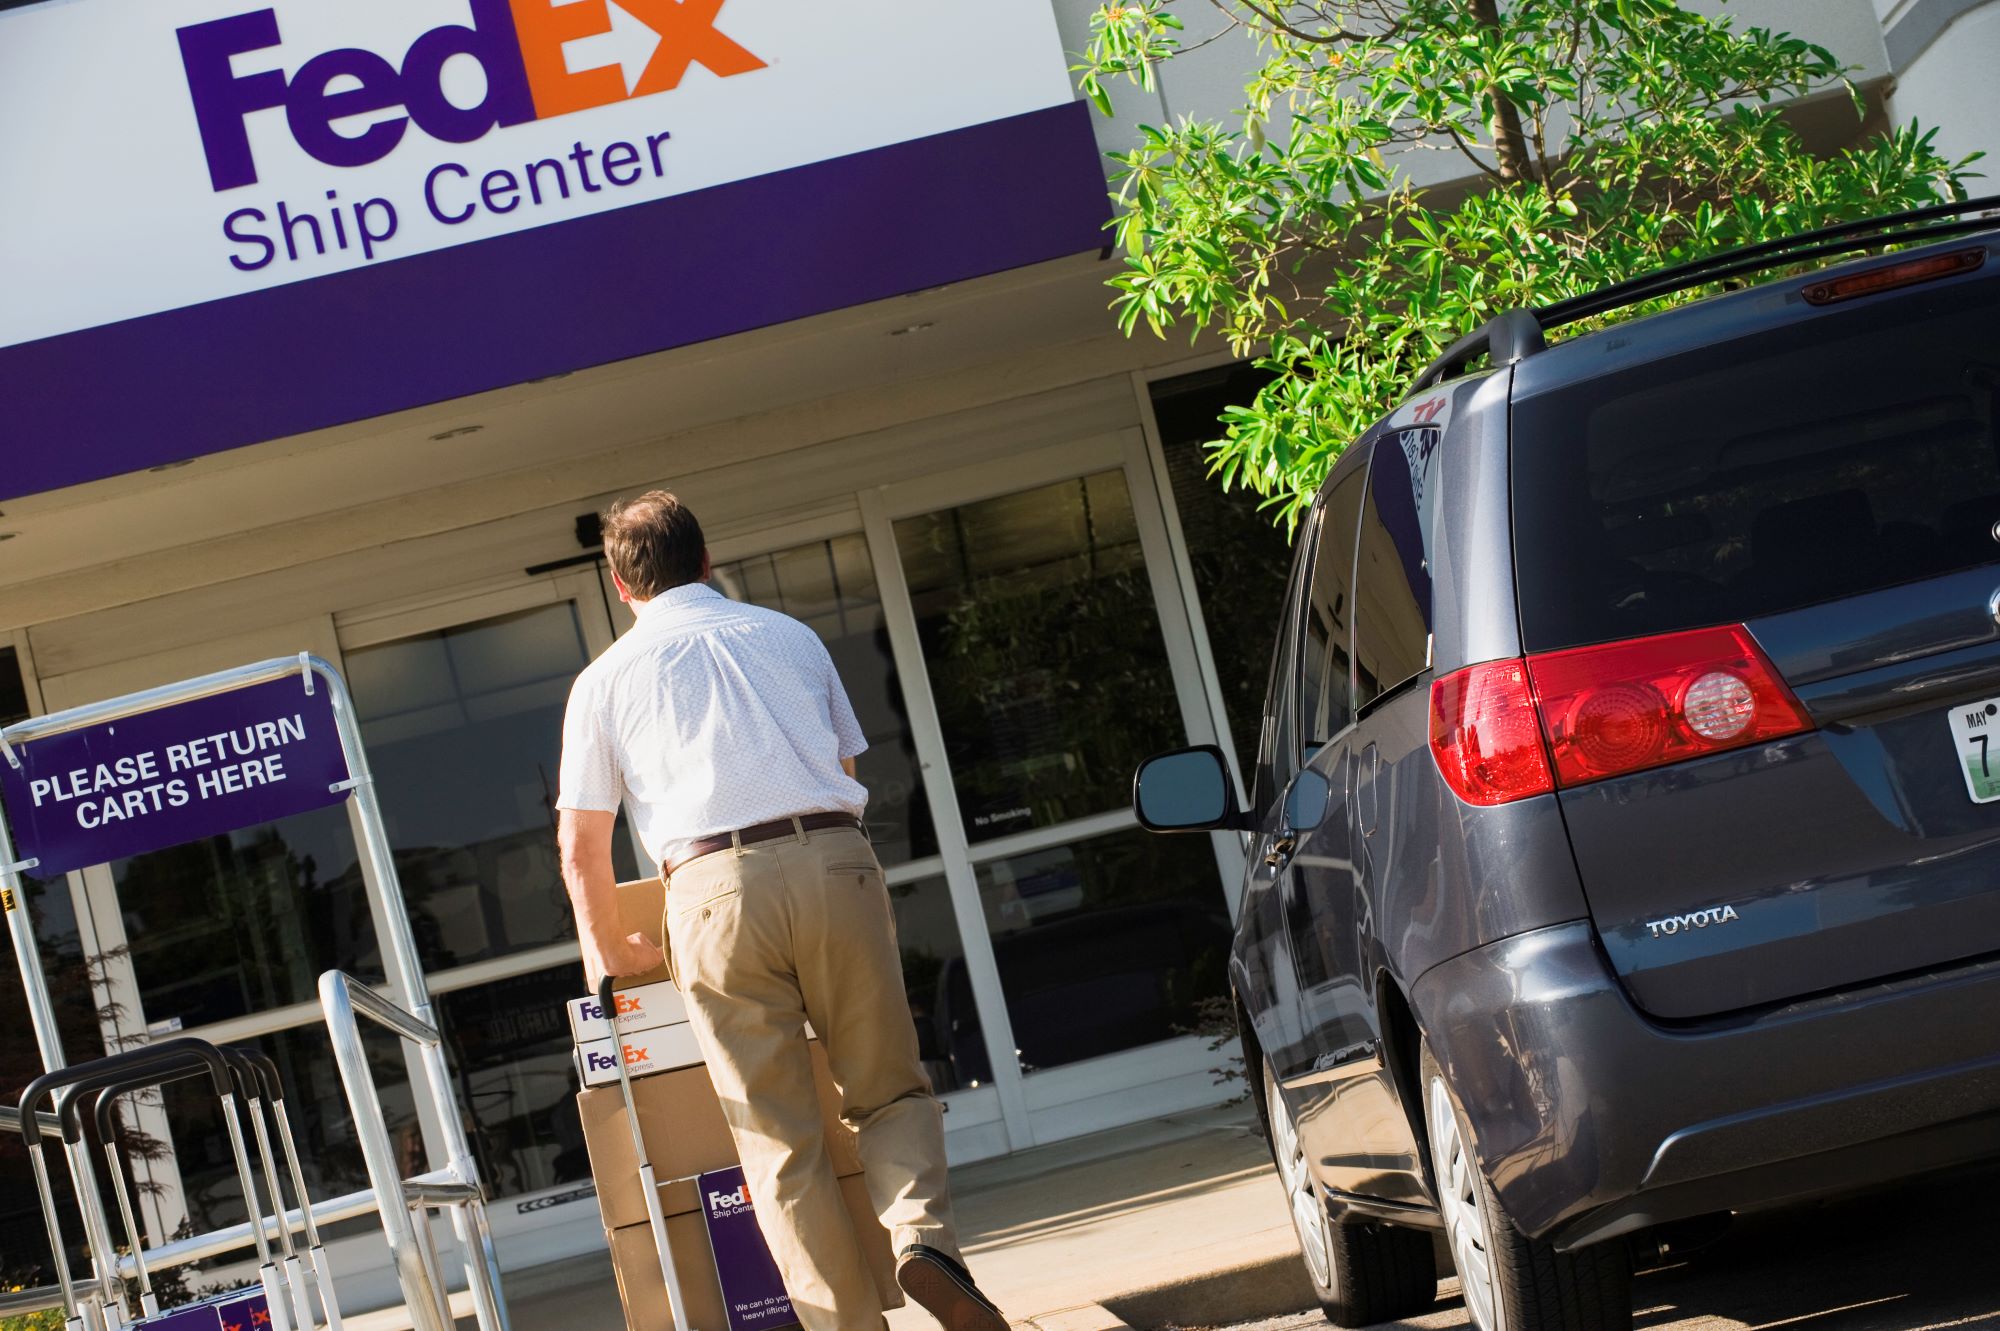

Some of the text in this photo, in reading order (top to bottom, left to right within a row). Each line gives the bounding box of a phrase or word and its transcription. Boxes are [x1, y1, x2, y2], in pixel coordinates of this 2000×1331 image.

[176, 0, 768, 192] FedEx
[222, 131, 671, 271] Ship Center
[1966, 710, 1987, 729] MAY
[30, 714, 305, 806] PLEASE RETURN
[1969, 734, 1989, 777] 7
[77, 753, 286, 829] CARTS HERE
[975, 807, 1031, 826] No Smoking
[1646, 905, 1739, 938] TOYOTA
[580, 995, 642, 1021] FeEx
[619, 1012, 647, 1024] Express
[708, 1184, 753, 1211] FedE
[713, 1204, 753, 1219] Ship Cente
[735, 1303, 748, 1312] We
[749, 1300, 763, 1308] can
[742, 1303, 791, 1321] heavy lifting!
